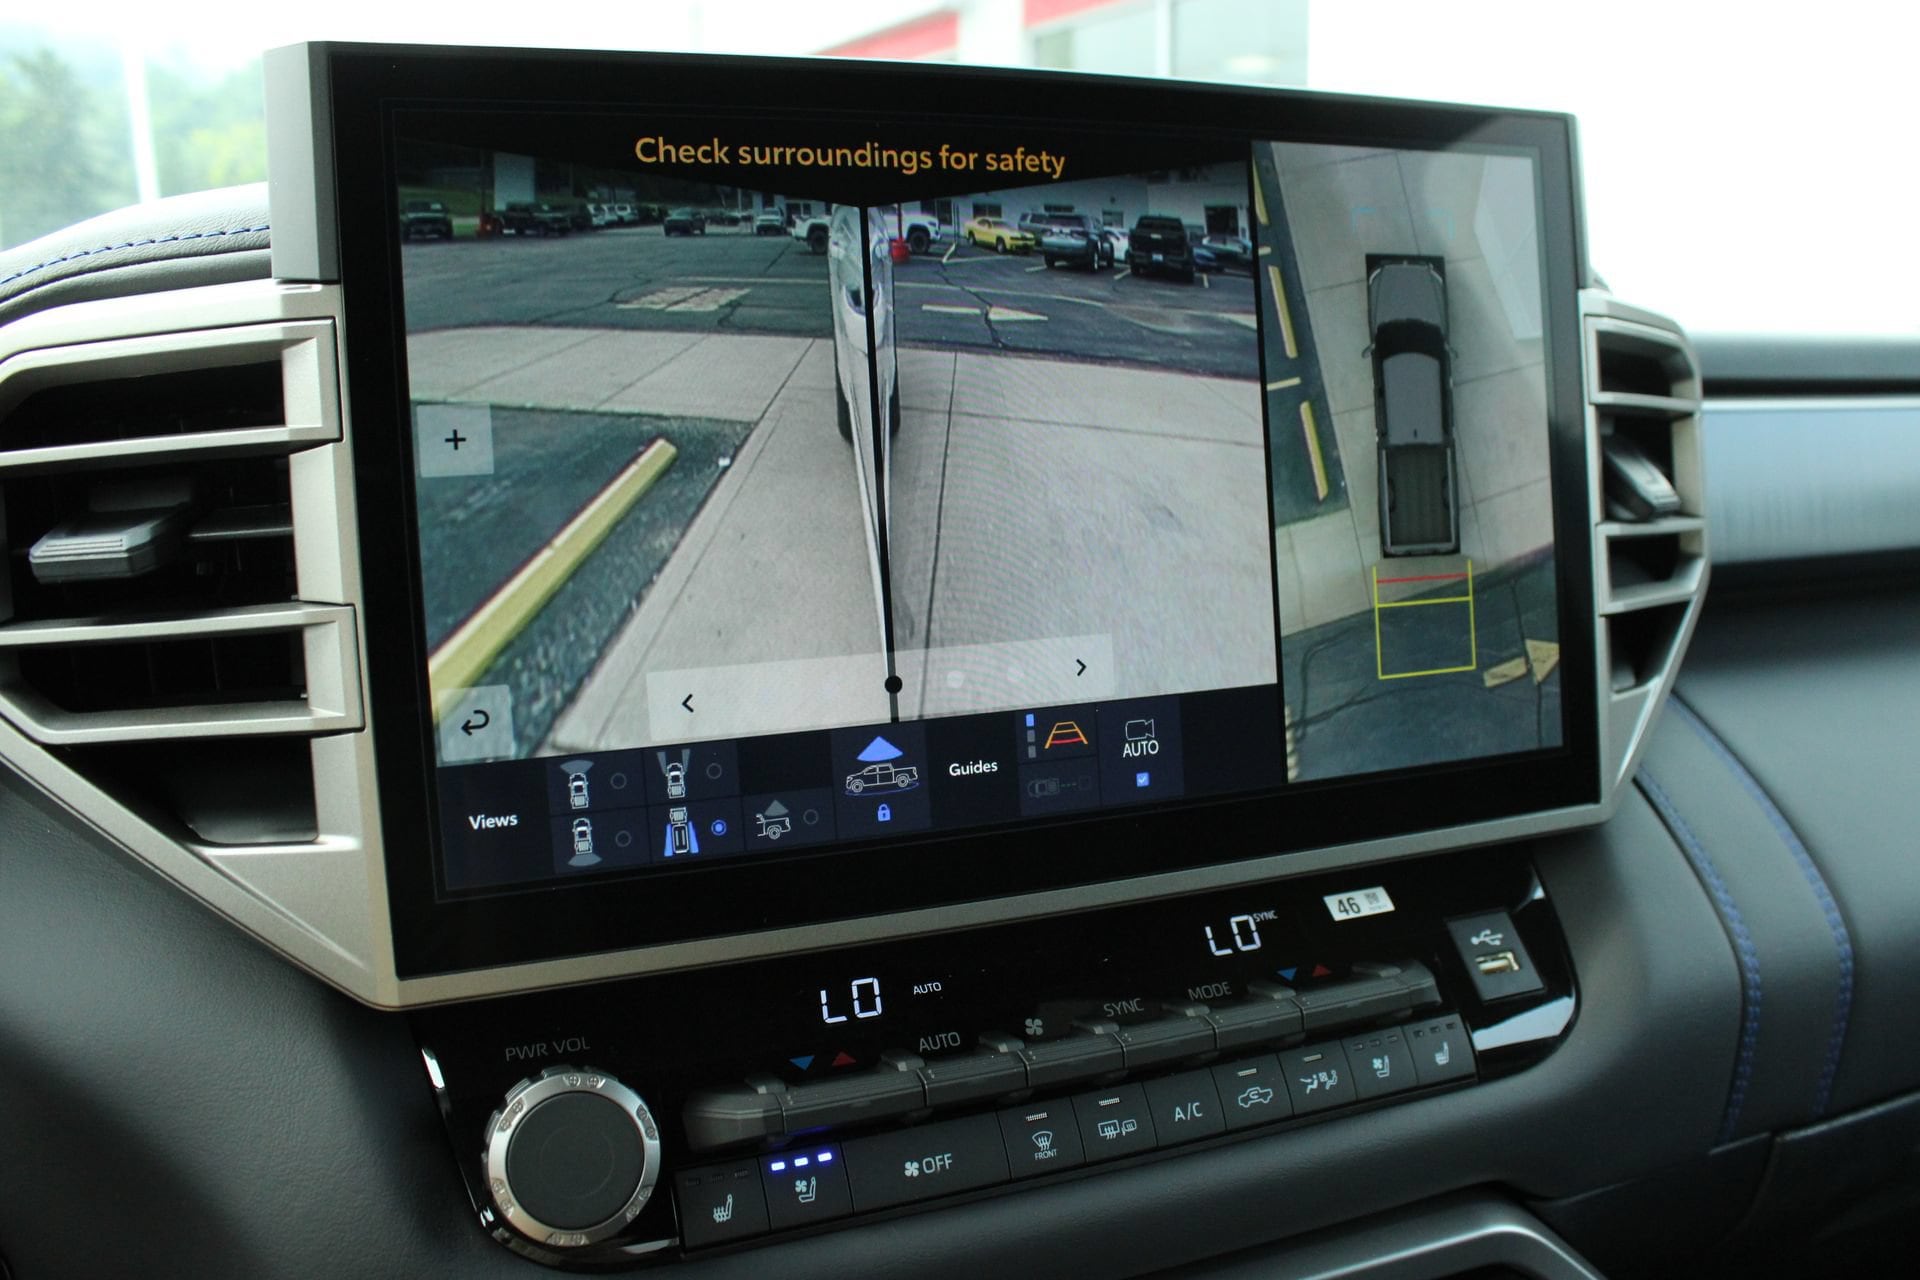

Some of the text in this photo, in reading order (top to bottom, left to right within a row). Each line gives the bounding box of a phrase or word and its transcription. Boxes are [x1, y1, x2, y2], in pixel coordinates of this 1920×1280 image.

[635, 137, 1066, 179] Check surroundings for safety
[1122, 739, 1159, 758] AUTO
[949, 759, 998, 777] Guides
[469, 814, 518, 831] Views
[1338, 897, 1361, 916] 46
[1252, 911, 1277, 922] SYNC
[1205, 915, 1261, 955] LO
[913, 982, 942, 995] AUTO
[1188, 982, 1232, 1001] MODE
[820, 977, 882, 1024] LO
[1103, 998, 1144, 1018] SYNC
[505, 1036, 591, 1062] PWR VOL
[919, 1031, 961, 1051] AUTO
[1174, 1102, 1203, 1122] A/C
[922, 1154, 953, 1174] OFF
[1034, 1148, 1057, 1161] FRONT
